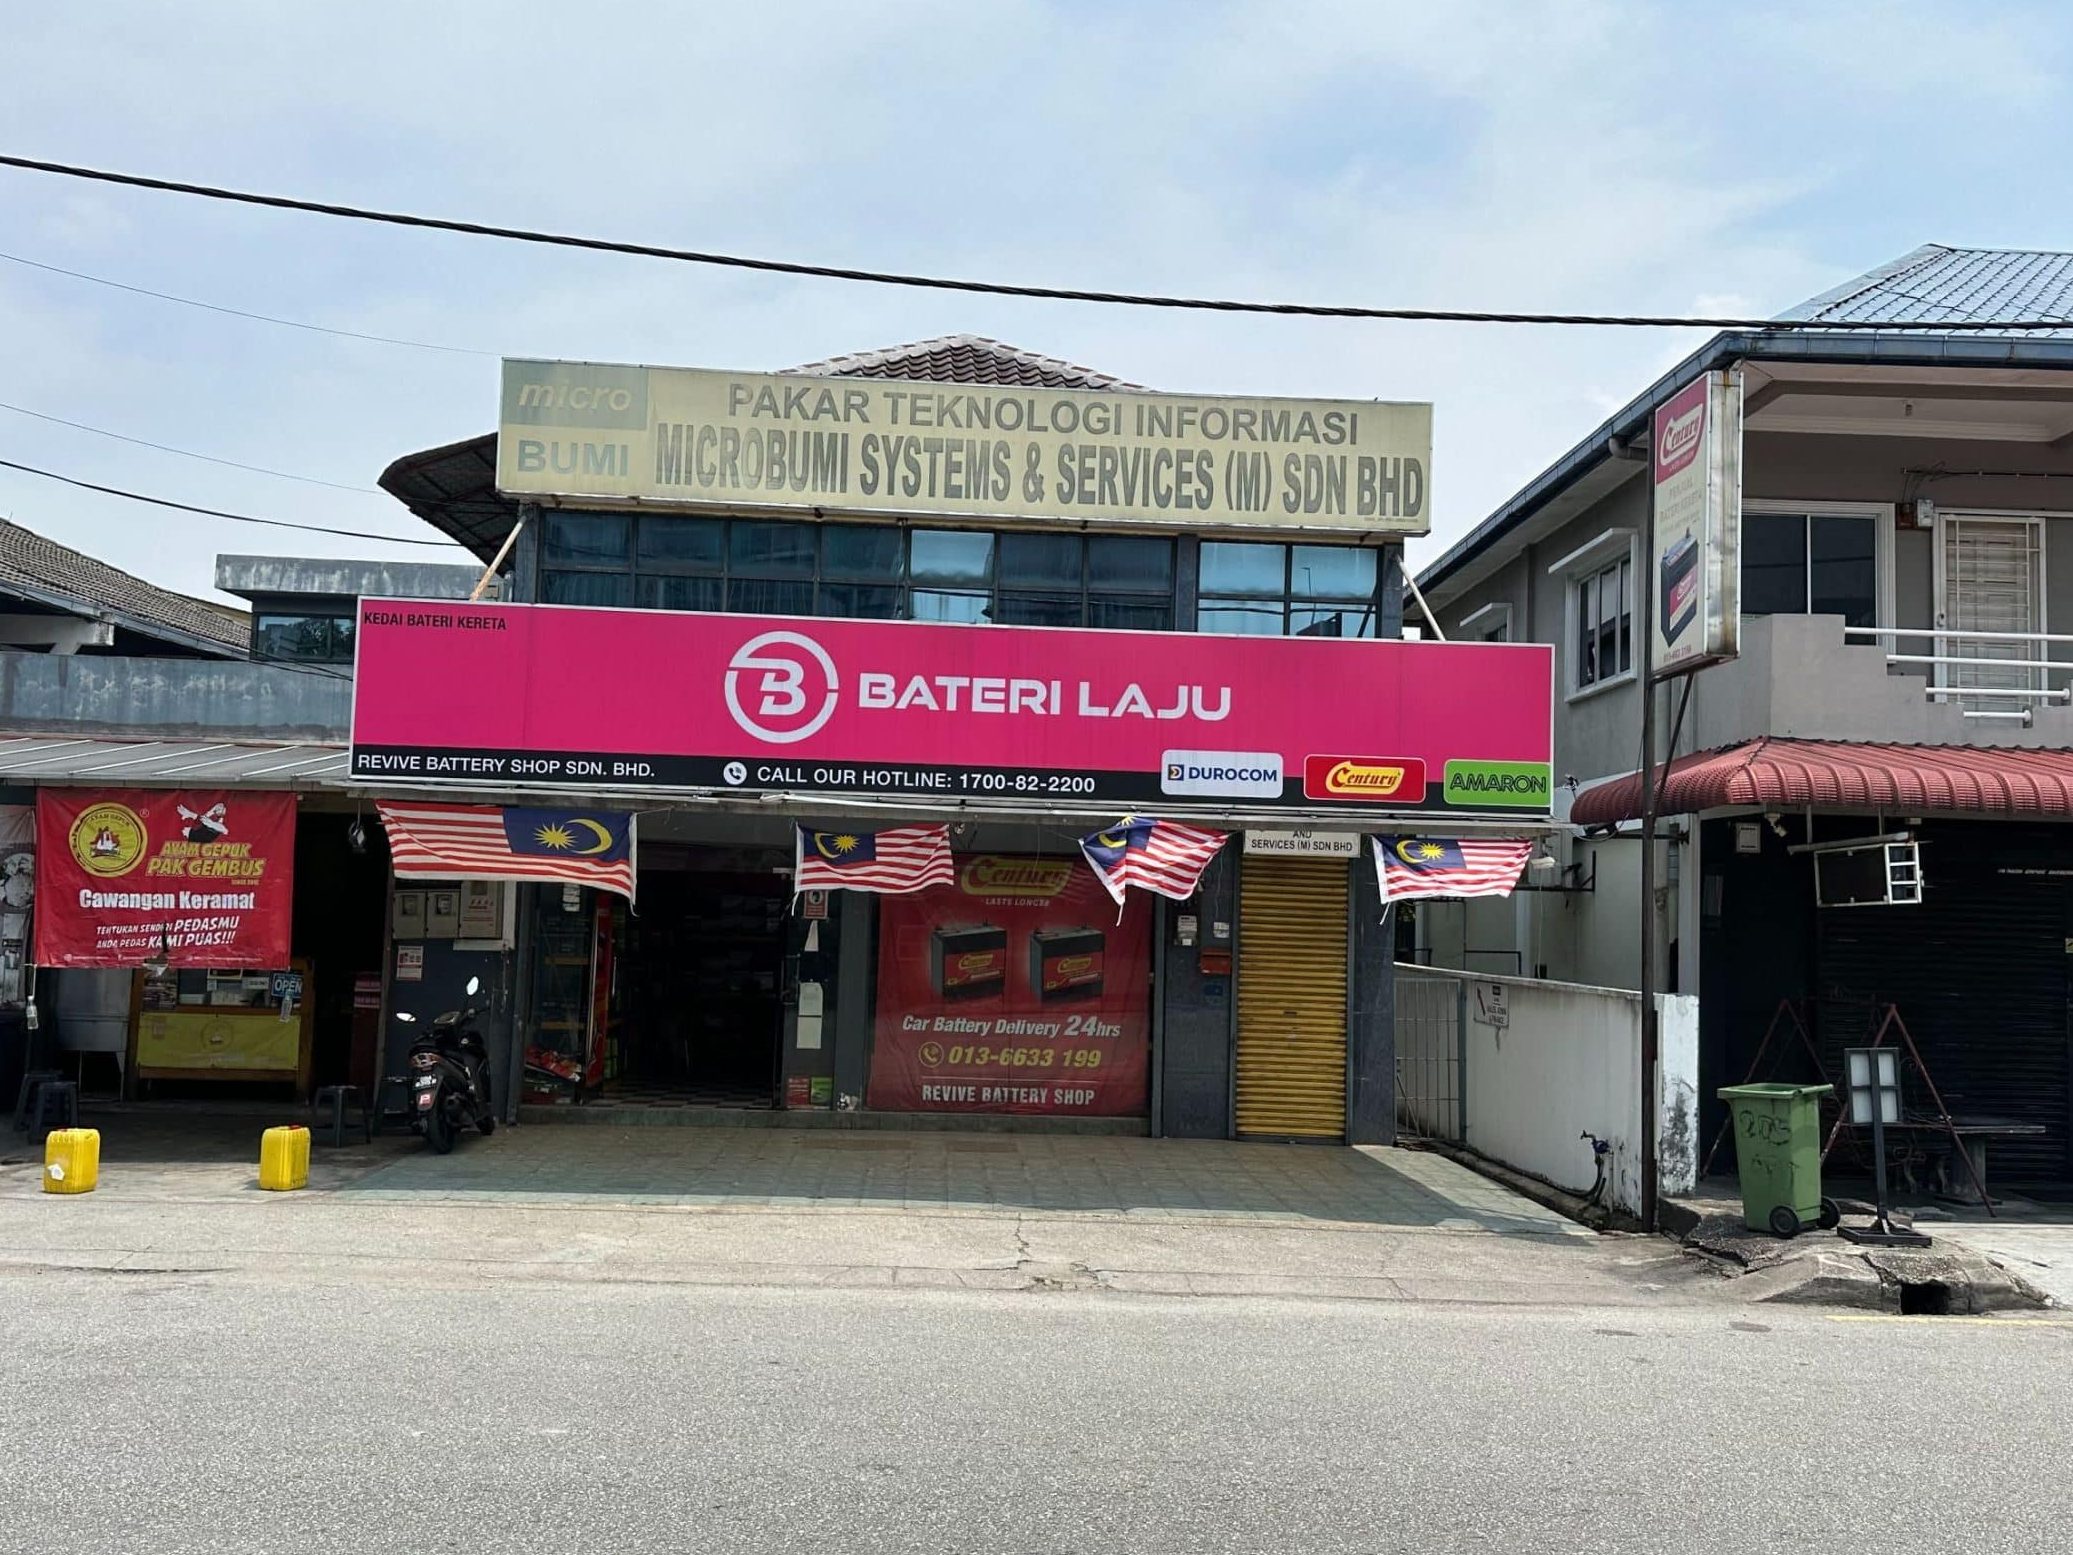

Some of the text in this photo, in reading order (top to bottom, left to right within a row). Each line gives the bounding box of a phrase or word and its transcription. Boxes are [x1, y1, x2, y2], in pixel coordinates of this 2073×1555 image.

[516, 380, 630, 412] micro
[728, 383, 1357, 445] PAKAR TEKNOLOGI INFORMASI
[517, 440, 628, 476] BUMI
[655, 422, 1423, 518] MICROBUMI SYSTEMS & SERVICES (M) SDN BHD
[364, 612, 507, 631] KEDAI BATERI KERETA
[858, 672, 1231, 721] BATERI LAJU
[358, 754, 655, 778] REVIVE BATTERY SHOP SDN. BHD.
[1188, 765, 1278, 783] DUROCOM
[1330, 760, 1401, 788] Century
[757, 766, 1095, 793] CALL OUR HOTLINE: 1700-82-2200
[1449, 772, 1547, 794] AMARON
[162, 842, 252, 858] AYAM GEPUK
[1251, 839, 1353, 852] SERVICES (M) SDN BHD
[146, 857, 266, 878] PAK GEMBUS
[79, 889, 255, 911] Cawangan Keramat
[174, 916, 240, 933] PEDASMU
[120, 937, 146, 948] PEDAS
[185, 931, 236, 945] PUAS!!!
[274, 979, 302, 993] OPEN
[902, 1015, 1121, 1038] Car Battery Delivery 24hrs
[949, 1045, 1101, 1068] 013-6633 199
[922, 1085, 1095, 1106] REVIVE BATTERY SHOP
